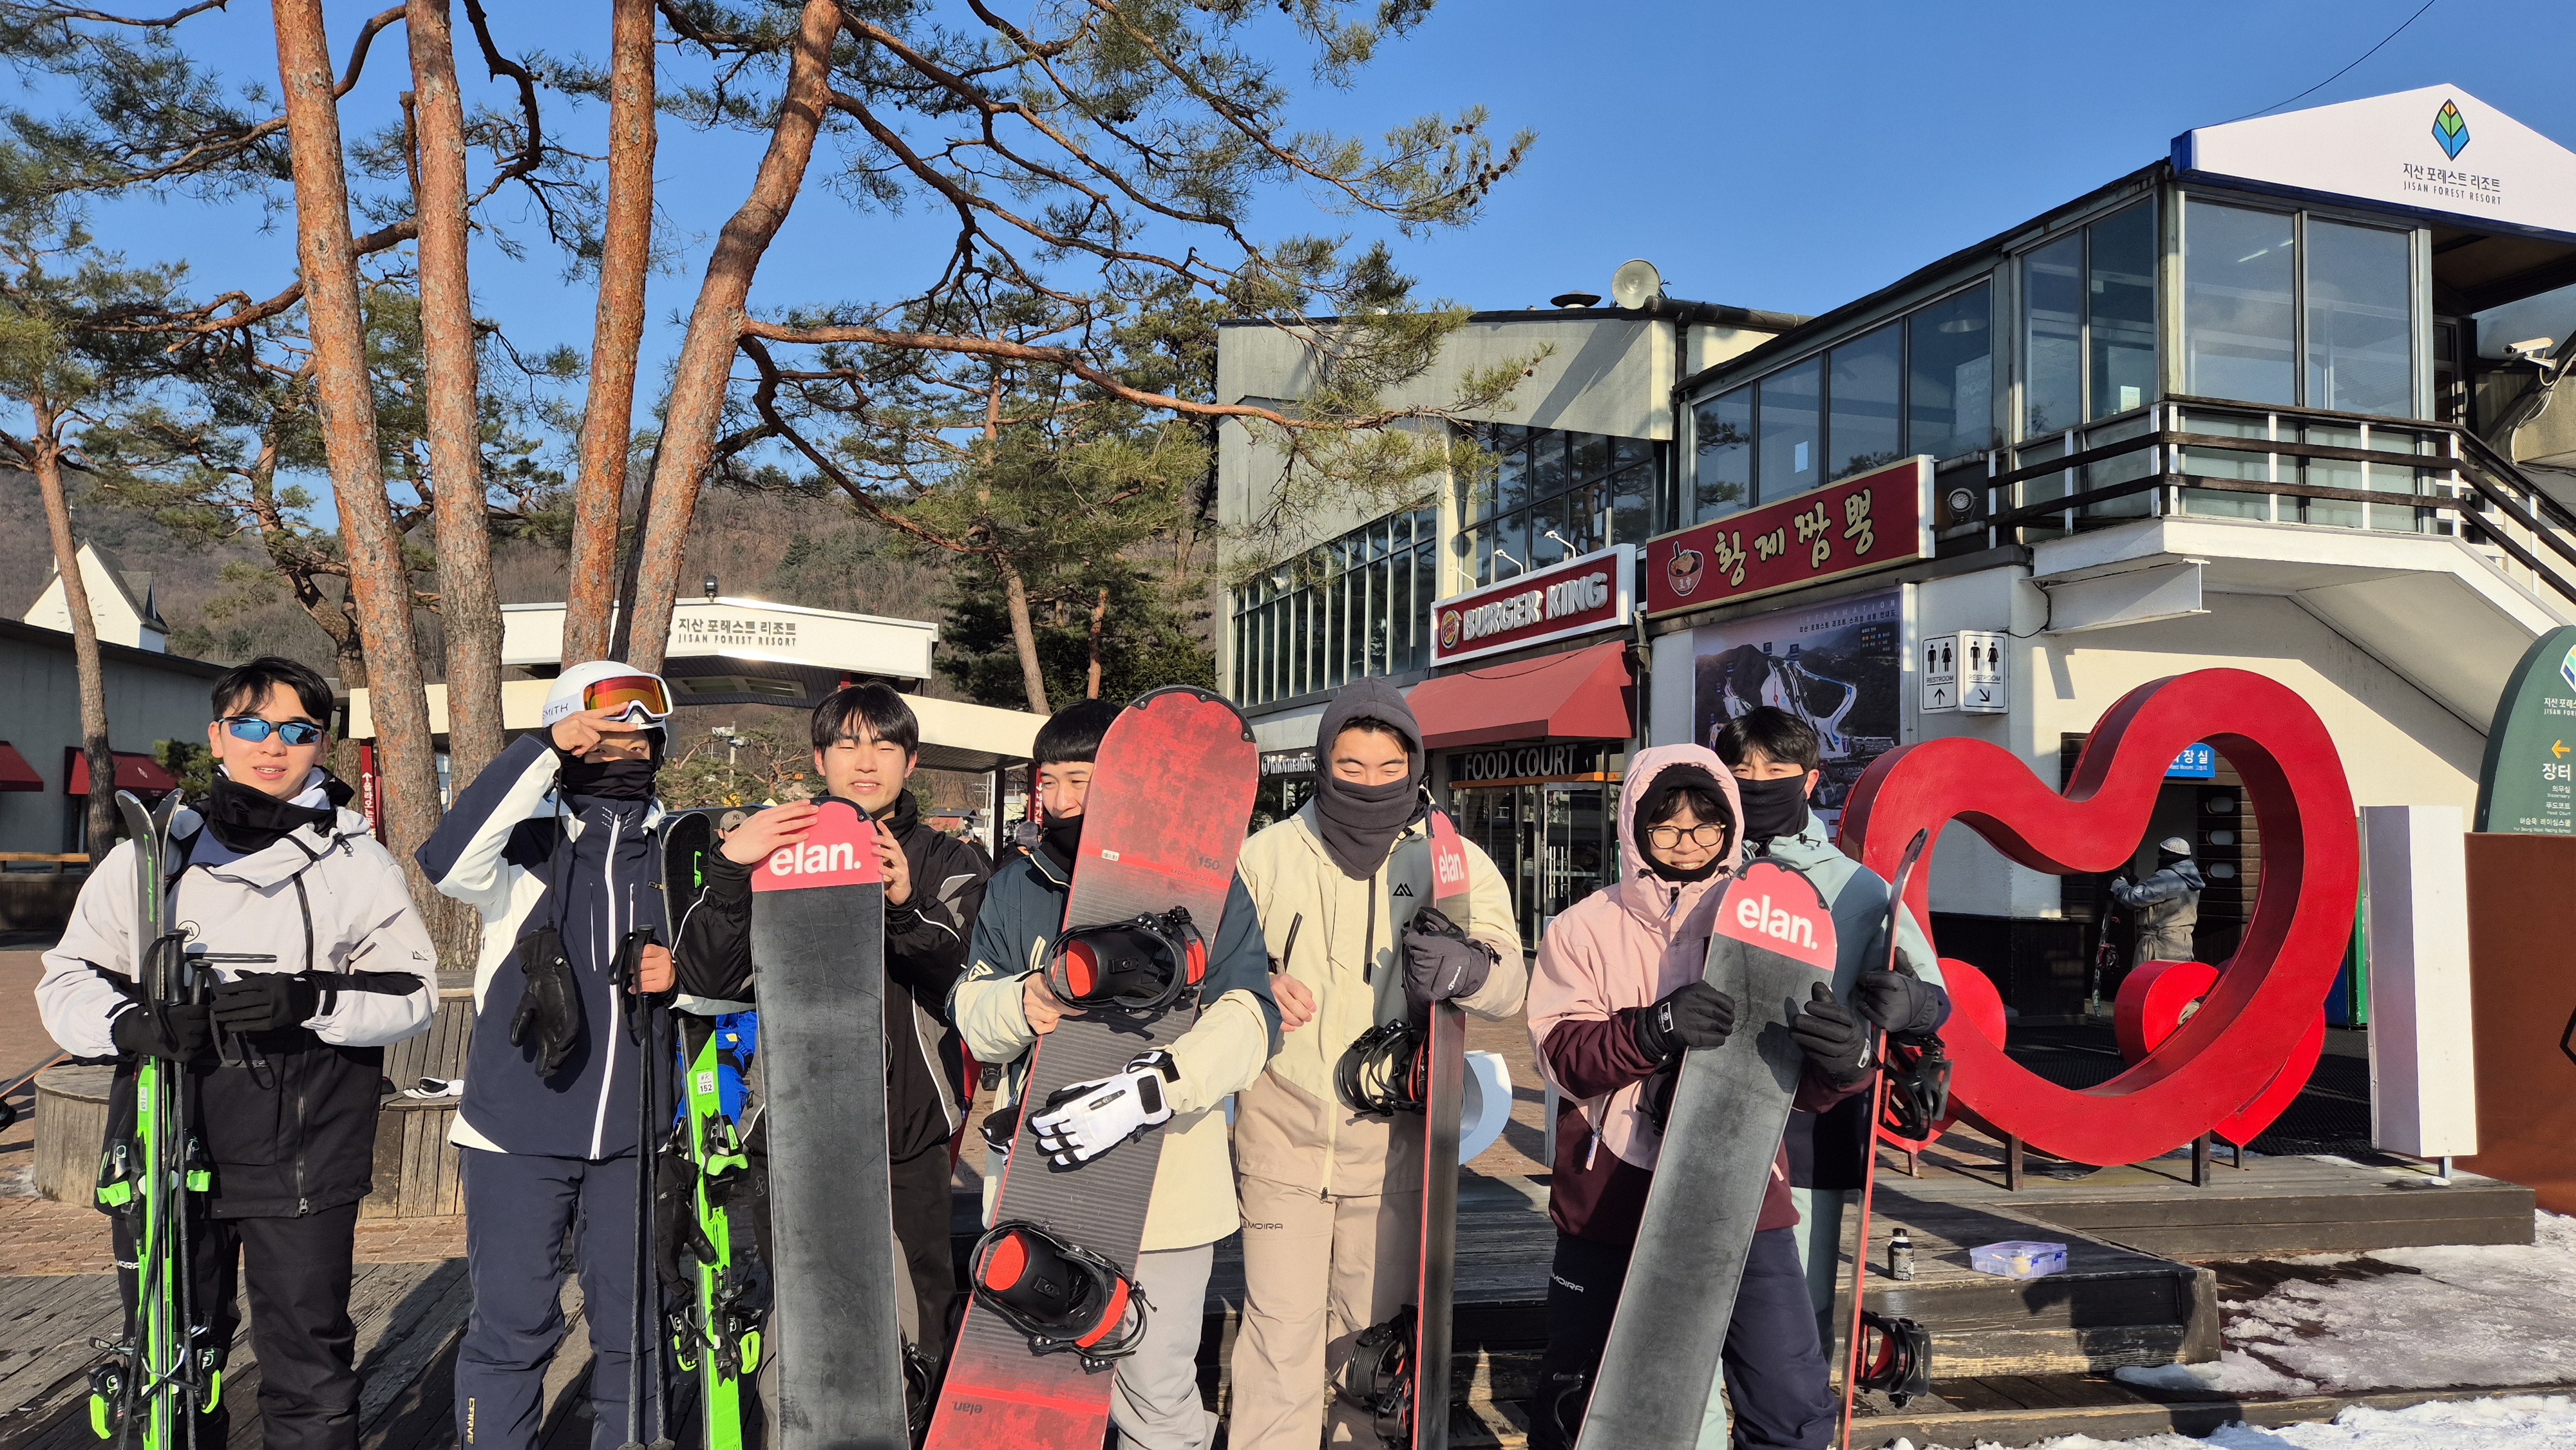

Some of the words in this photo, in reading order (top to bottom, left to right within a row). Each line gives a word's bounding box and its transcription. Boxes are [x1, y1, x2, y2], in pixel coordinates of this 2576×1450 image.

[2403, 163, 2424, 180] 지산
[2427, 167, 2467, 187] 포레스트
[2470, 174, 2501, 193] 리조트
[2403, 180, 2429, 193] JISAN
[2434, 185, 2465, 199] FOREST
[2469, 192, 2501, 205] RESORT
[1463, 590, 1544, 641] BURGER
[1546, 572, 1608, 620] KING
[678, 618, 704, 633] 지산
[707, 619, 756, 634] 포레스트
[760, 621, 797, 636] 리조트
[678, 634, 708, 643] JISAN
[714, 635, 752, 645] FOREST
[758, 637, 797, 646] RESORT
[1926, 675, 1954, 683] RESTROOM
[2544, 697, 2558, 708] 지산
[542, 702, 569, 720] SMITH
[1464, 750, 1510, 781] FOOD
[1515, 744, 1578, 777] COURT
[2174, 749, 2208, 764] 장실
[2542, 763, 2571, 782] 장터
[2552, 785, 2571, 794] 의무실
[1198, 856, 1221, 871] 150
[1170, 868, 1193, 878] explore
[699, 1084, 712, 1093] 152
